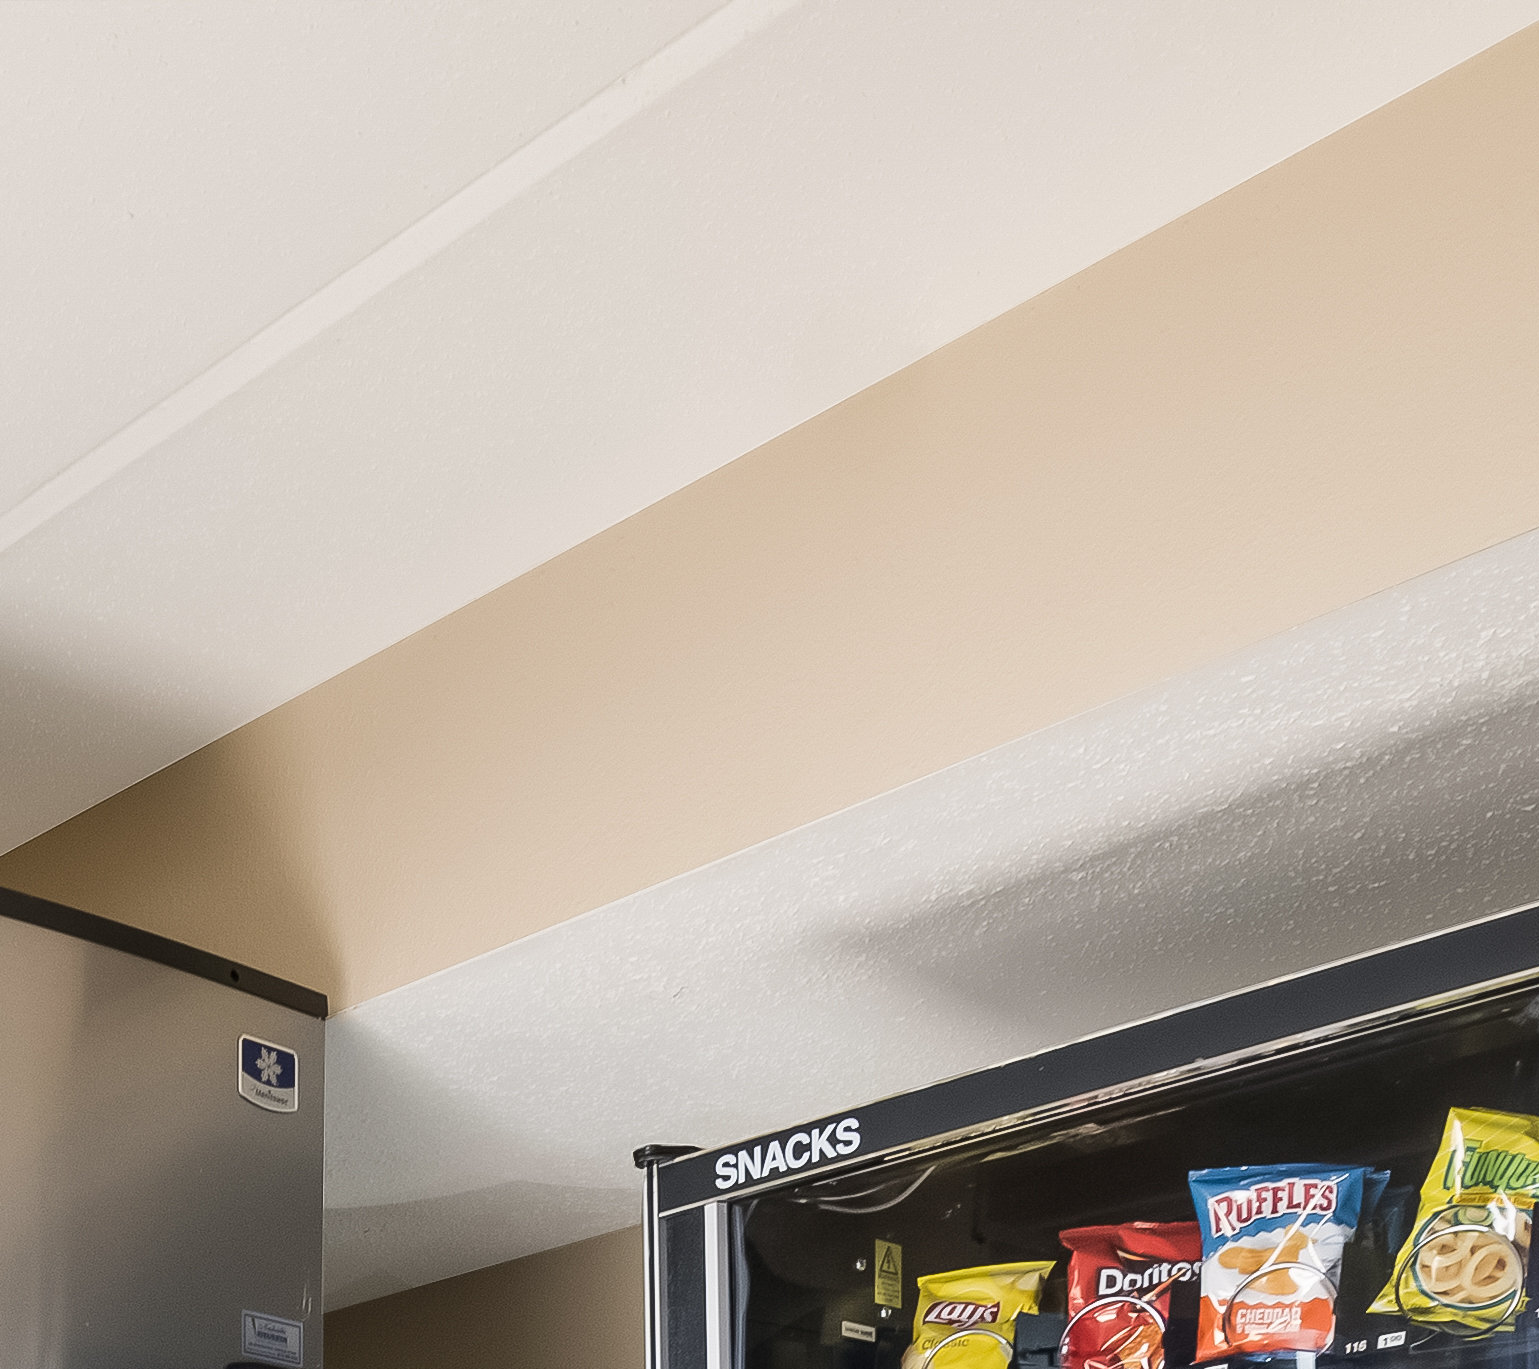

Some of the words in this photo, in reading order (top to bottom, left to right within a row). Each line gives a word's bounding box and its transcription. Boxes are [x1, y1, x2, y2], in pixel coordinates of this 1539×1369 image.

[715, 1118, 860, 1189] SNACKS
[1215, 1182, 1335, 1234] RUFFLES
[925, 1302, 997, 1329] Lay's
